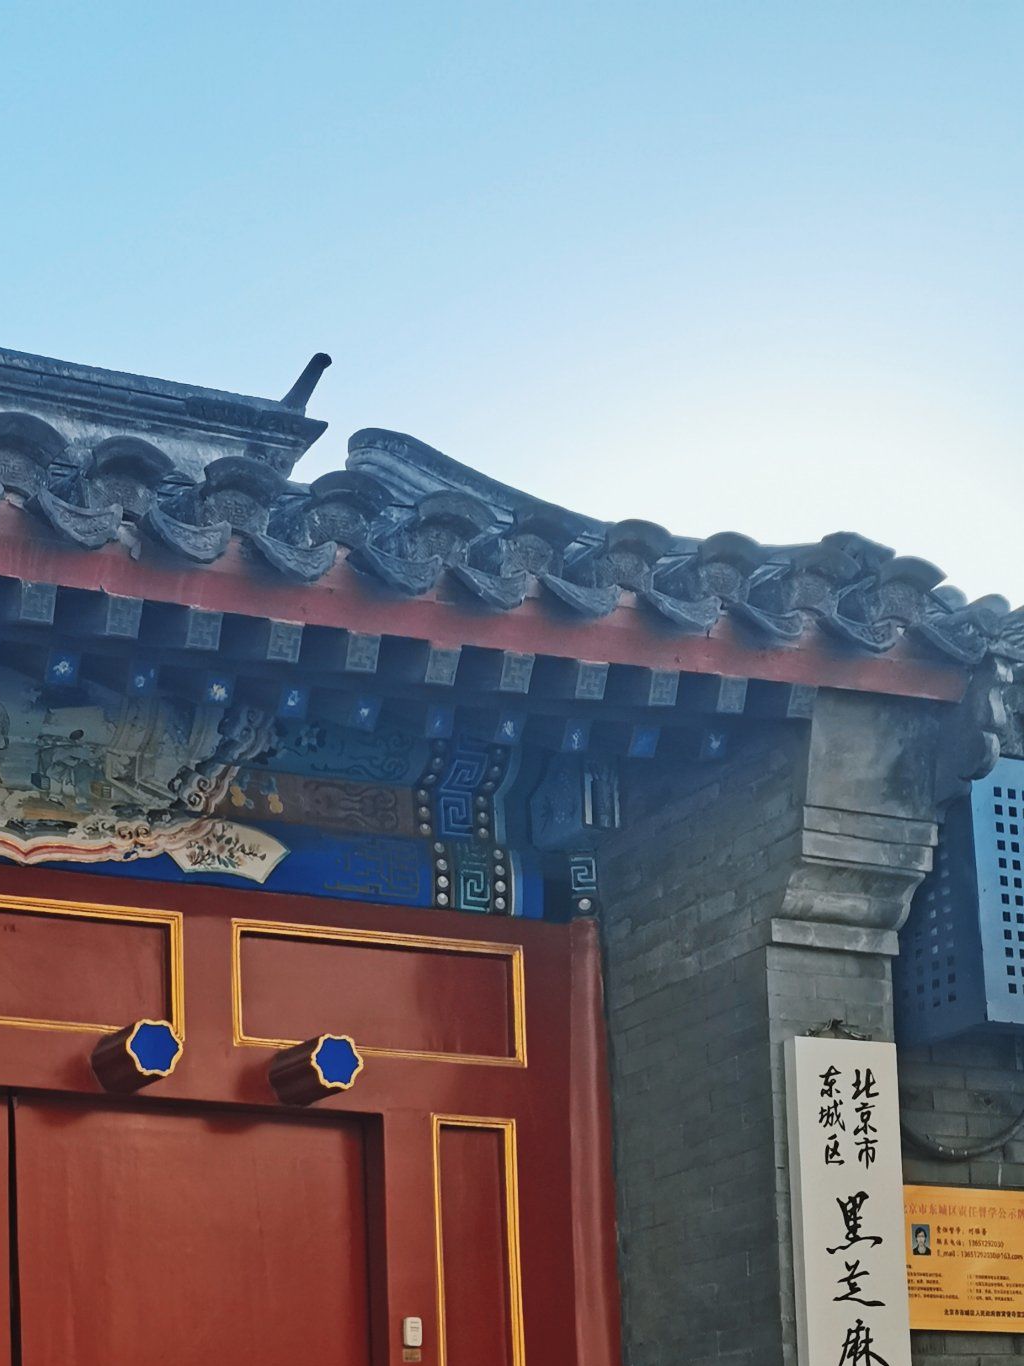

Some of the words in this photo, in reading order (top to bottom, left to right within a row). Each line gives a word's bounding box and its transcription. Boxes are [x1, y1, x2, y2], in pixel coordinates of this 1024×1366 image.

[819, 1065, 845, 1165] 东城区
[852, 1068, 879, 1170] 北京市
